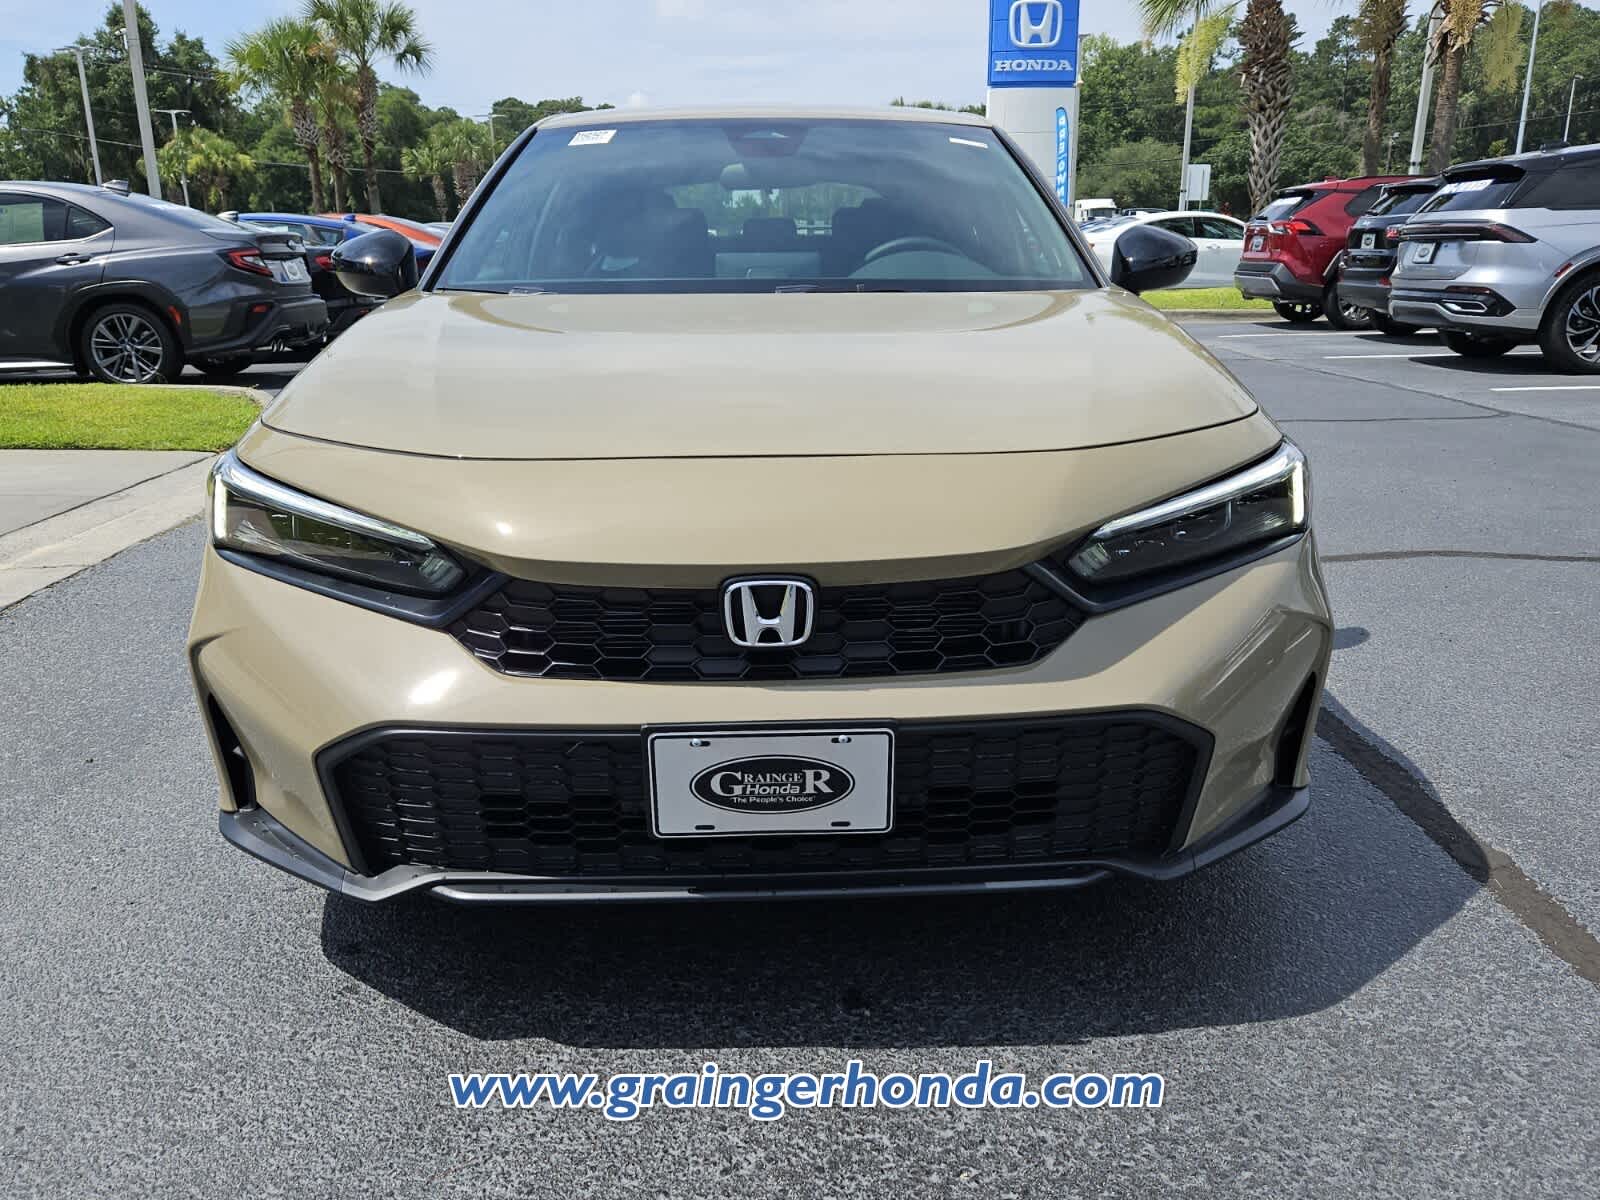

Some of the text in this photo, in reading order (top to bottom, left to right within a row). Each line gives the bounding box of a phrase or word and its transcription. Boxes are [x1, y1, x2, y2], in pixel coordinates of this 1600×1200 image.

[994, 59, 1073, 72] HONDA
[710, 769, 834, 797] GRAINGER
[745, 783, 801, 795] Honda
[732, 796, 747, 804] The
[749, 796, 783, 804] People's
